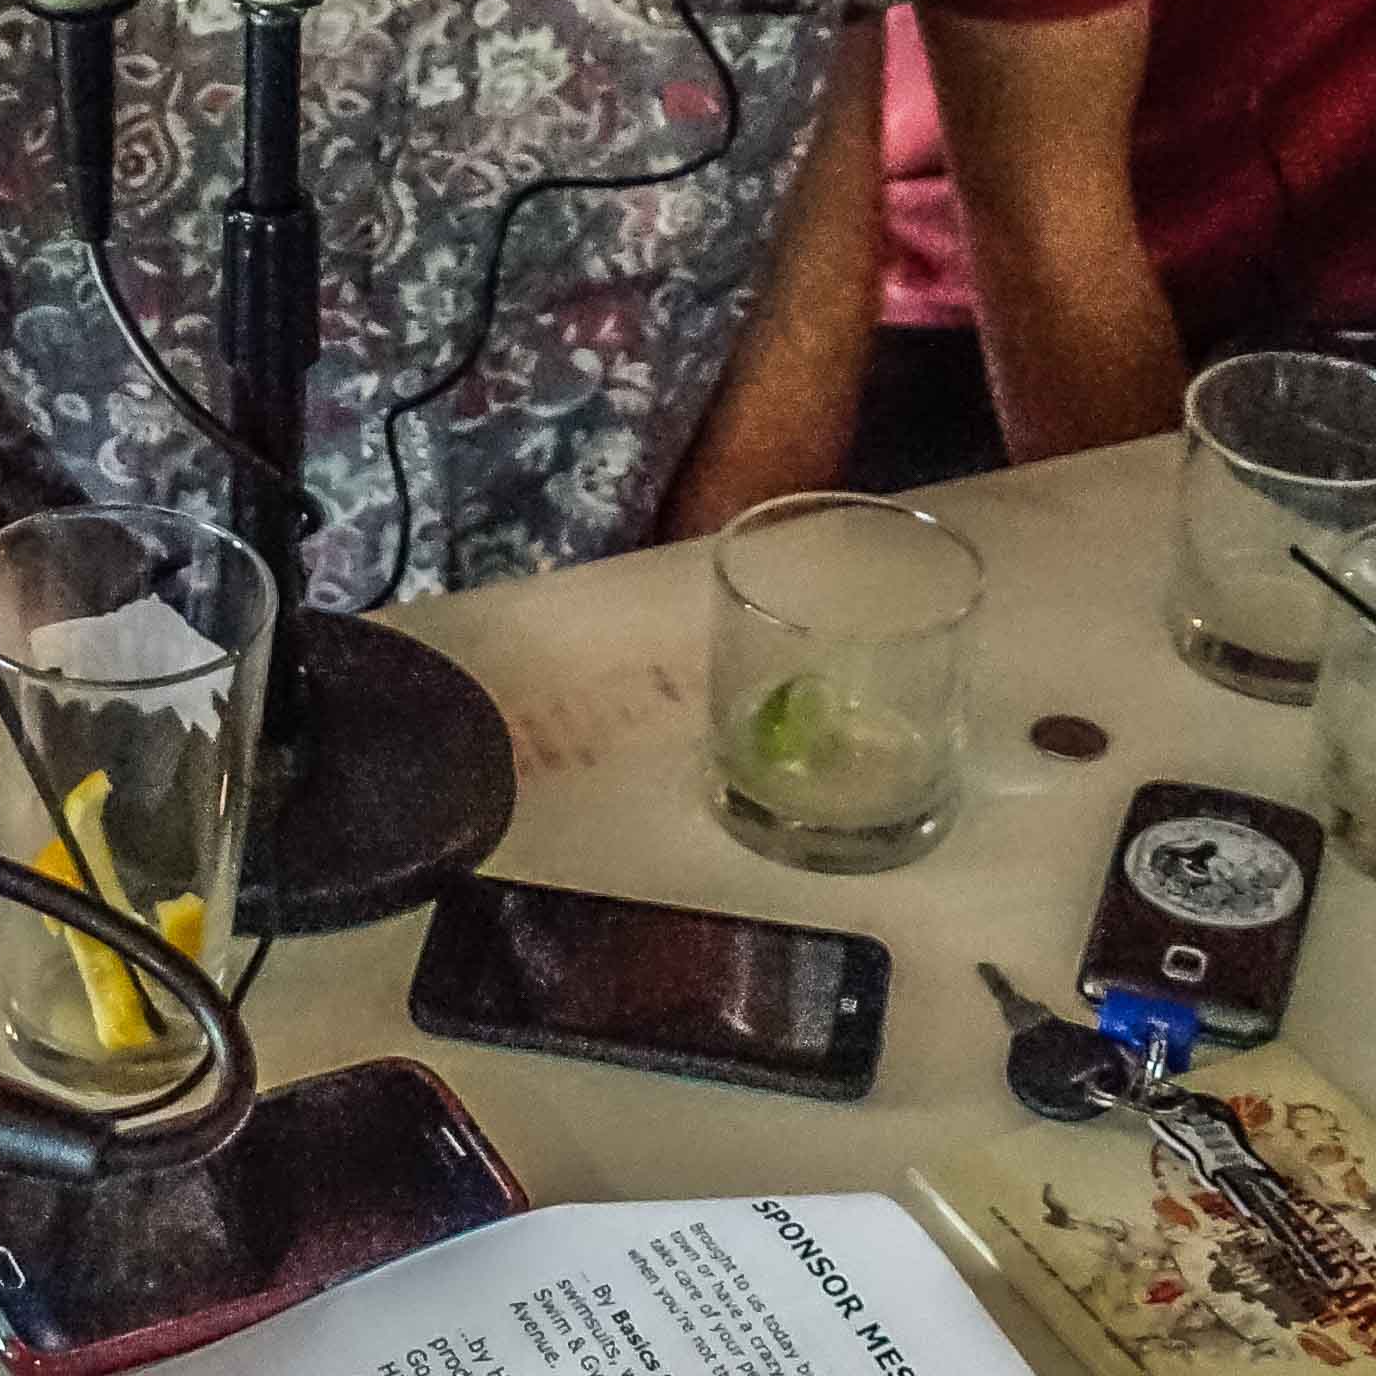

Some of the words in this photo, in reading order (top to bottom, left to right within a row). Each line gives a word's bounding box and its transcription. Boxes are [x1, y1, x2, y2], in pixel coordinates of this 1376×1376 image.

[650, 1238, 678, 1267] take
[670, 1230, 701, 1261] town
[697, 1264, 716, 1277] or
[712, 1280, 744, 1319] have
[739, 1320, 753, 1333] a
[674, 1270, 703, 1301] care
[689, 1222, 737, 1273] Brought
[732, 1274, 750, 1291] to
[746, 1294, 767, 1312] us
[762, 1313, 799, 1360] today
[752, 1199, 864, 1320] SPONSOR
[509, 1299, 560, 1369] Avenue.
[533, 1287, 573, 1335] Swim
[567, 1336, 586, 1354] &
[555, 1278, 622, 1367] swimsuits,
[591, 1284, 616, 1308] By
[611, 1309, 661, 1371] Basics
[627, 1248, 661, 1285] when
[653, 1285, 696, 1334] you're
[692, 1336, 718, 1364] not
[700, 1304, 722, 1318] of
[709, 1322, 746, 1357] your
